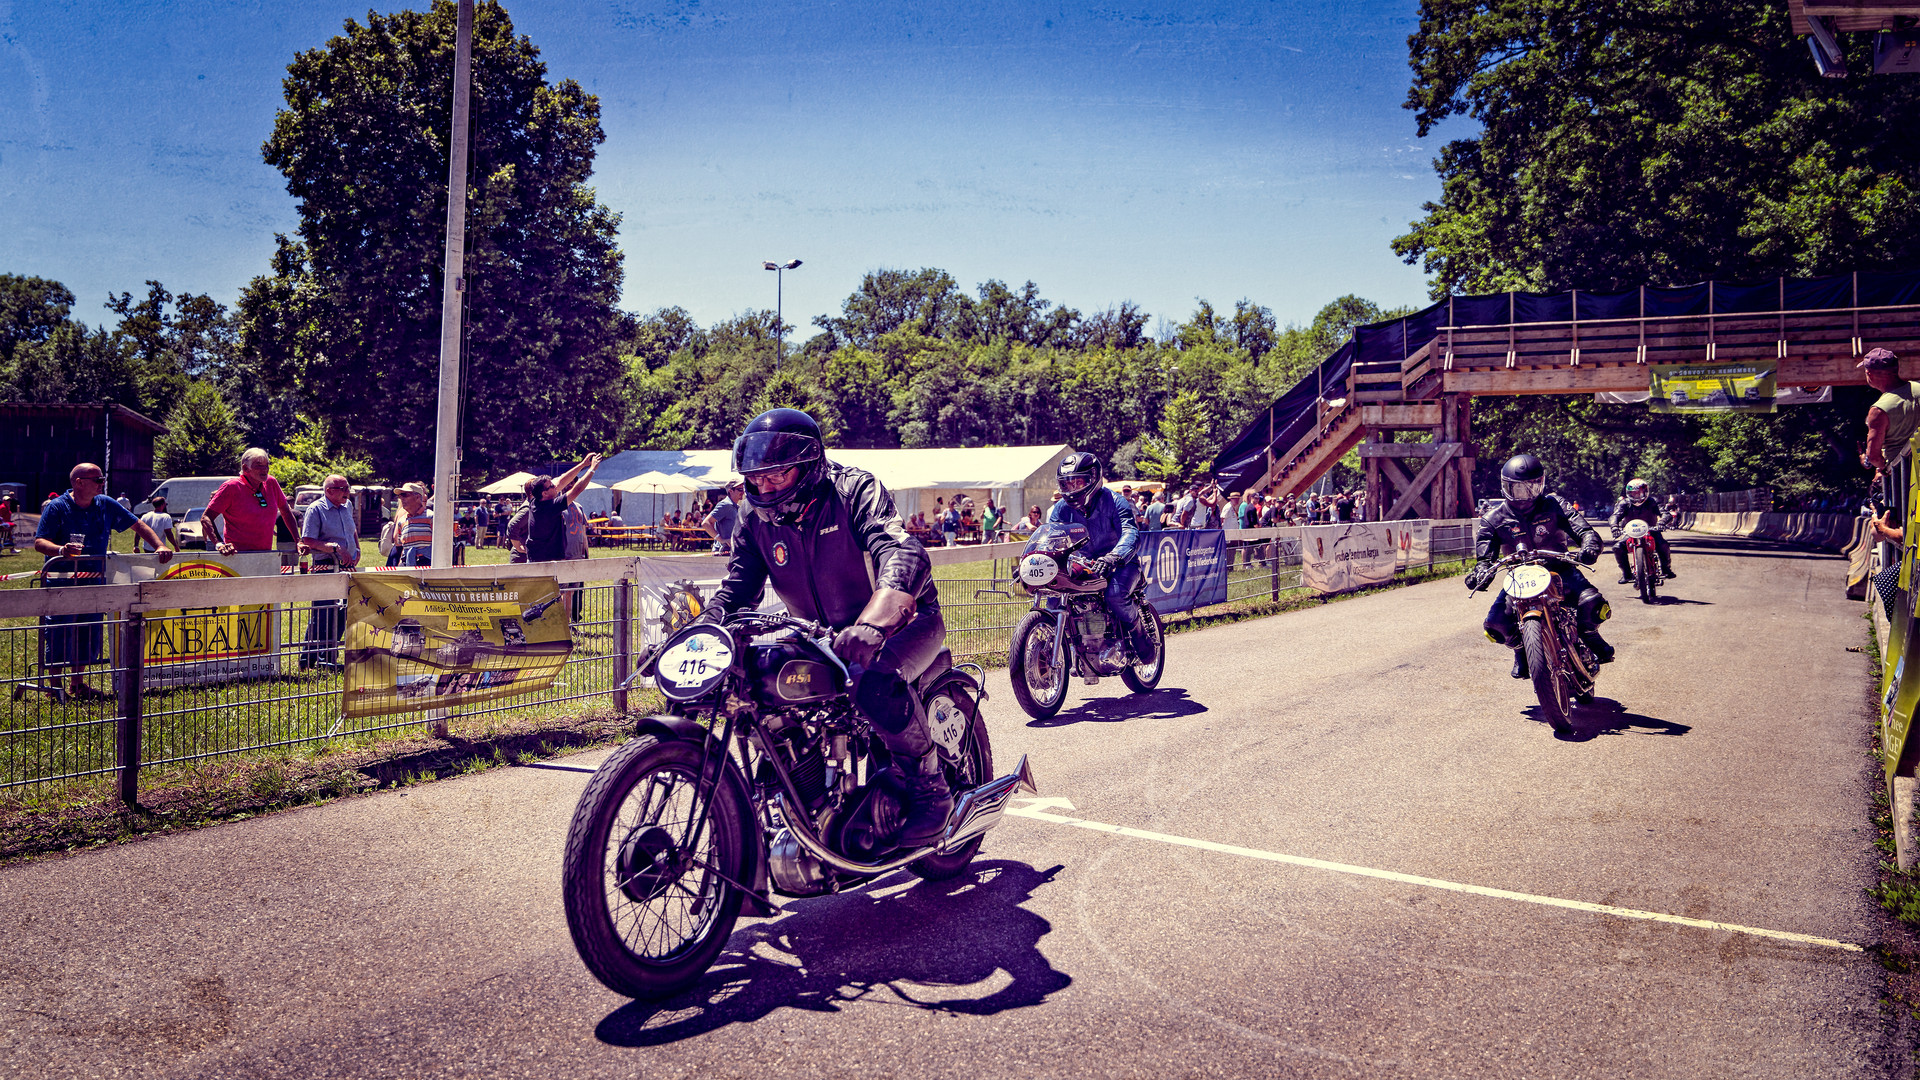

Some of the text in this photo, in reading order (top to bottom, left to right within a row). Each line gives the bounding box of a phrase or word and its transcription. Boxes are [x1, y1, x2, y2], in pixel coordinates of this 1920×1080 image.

[1029, 568, 1044, 578] 405
[1520, 580, 1537, 589] 418
[420, 591, 451, 601] CONVOY
[455, 593, 466, 602] TO
[470, 591, 519, 602] REMEMBER
[147, 605, 264, 656] ABAM
[174, 670, 201, 679] Blechs
[252, 663, 275, 674] Brugg
[678, 659, 707, 675] 416
[786, 673, 812, 685] BSA
[943, 723, 958, 743] 416
